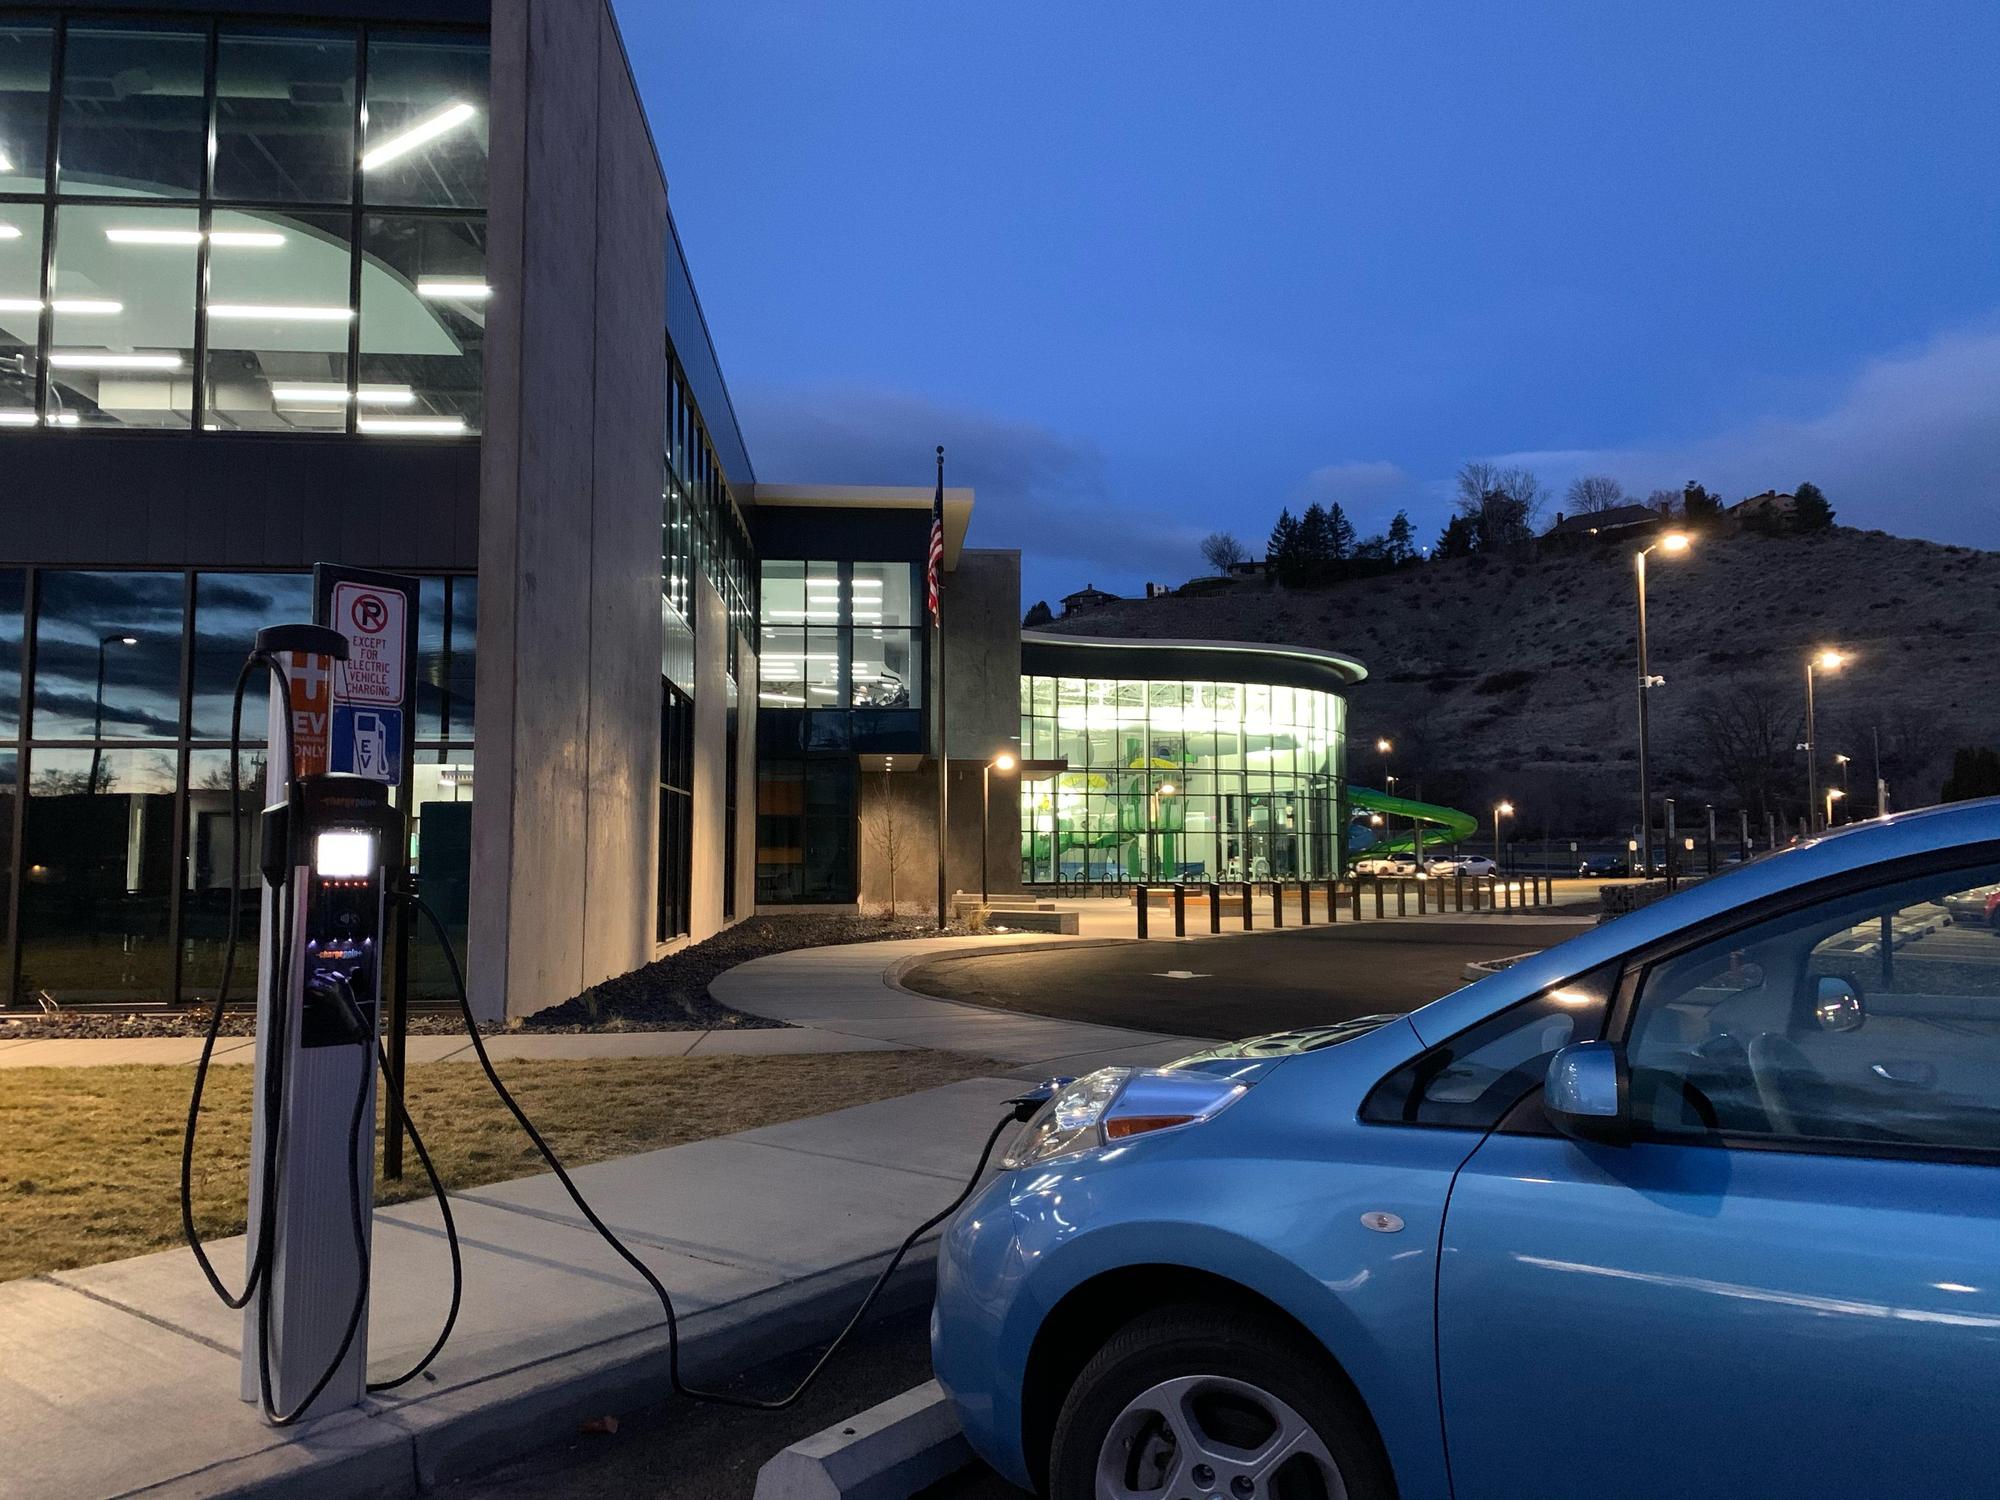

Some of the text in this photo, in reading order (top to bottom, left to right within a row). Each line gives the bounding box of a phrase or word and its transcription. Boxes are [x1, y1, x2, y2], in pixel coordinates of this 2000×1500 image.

[352, 636, 387, 650] EXCEPT
[360, 648, 378, 660] FOR
[347, 659, 390, 673] ELECTRIC
[349, 671, 387, 685] VEHICLE
[347, 682, 390, 697] CHARGING
[292, 711, 327, 735] EV
[361, 739, 372, 769] EV
